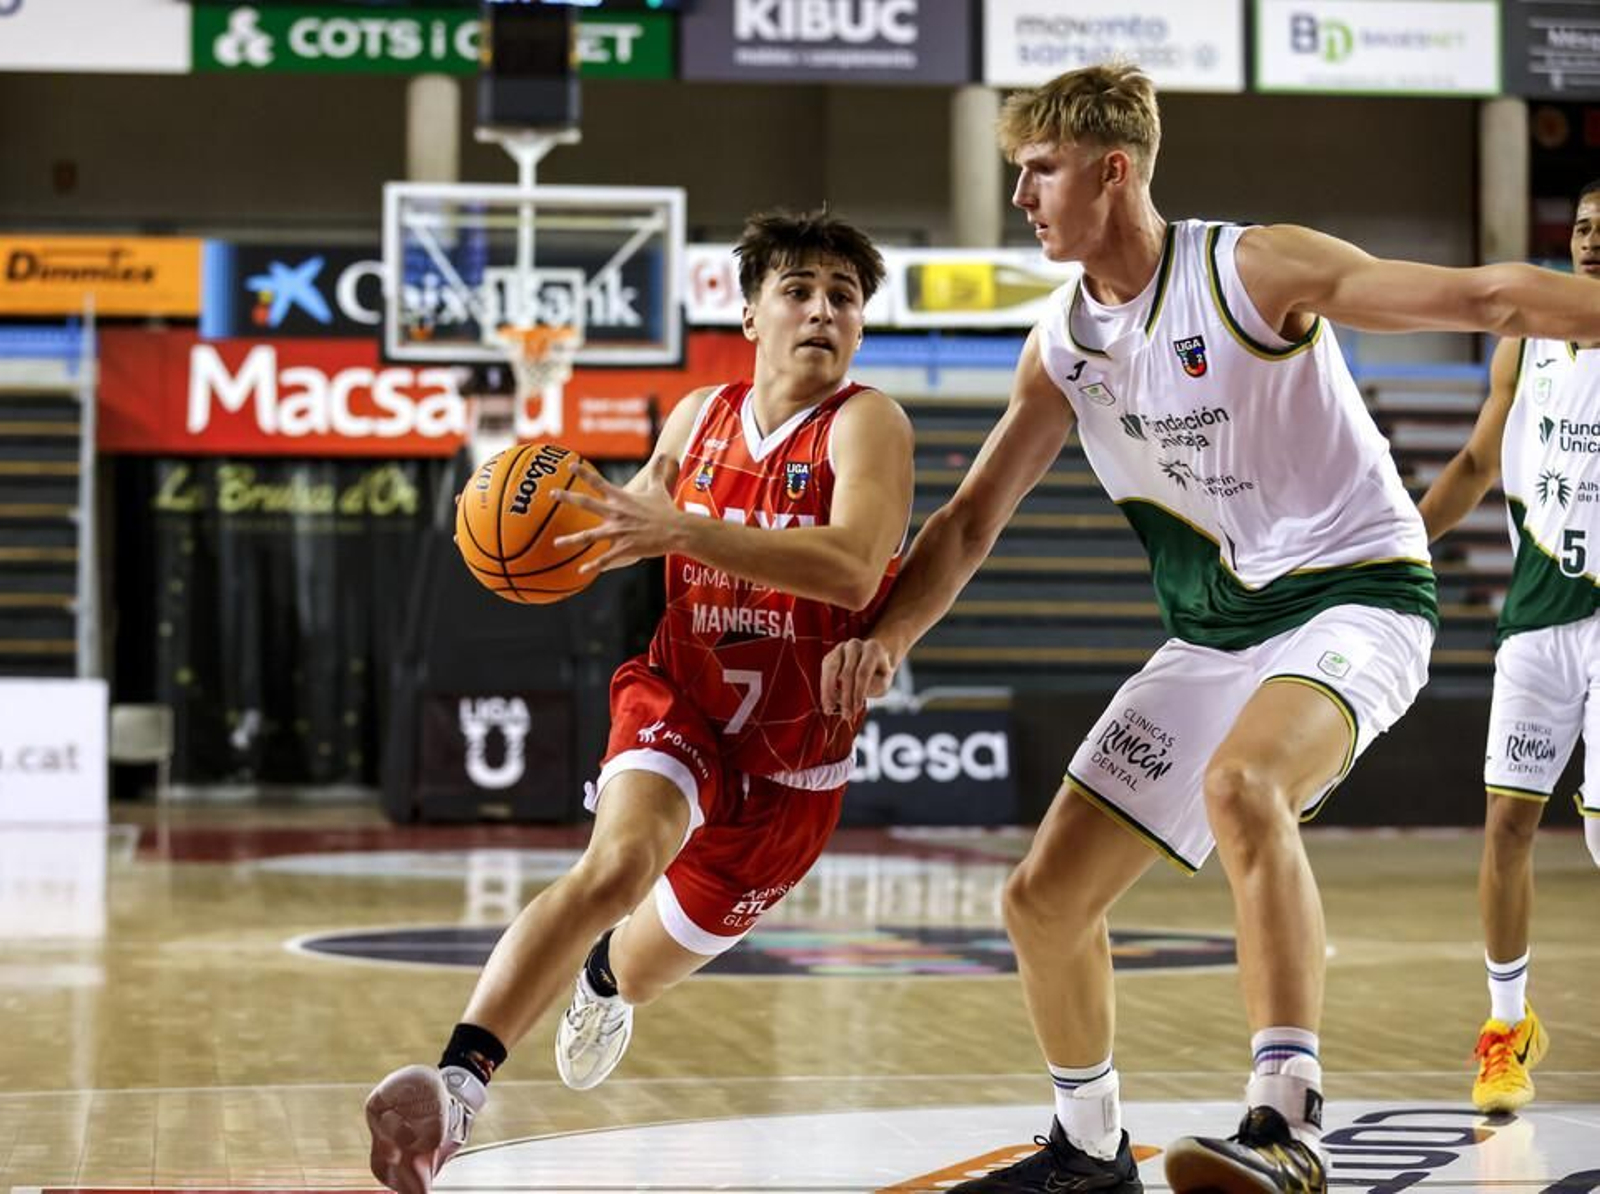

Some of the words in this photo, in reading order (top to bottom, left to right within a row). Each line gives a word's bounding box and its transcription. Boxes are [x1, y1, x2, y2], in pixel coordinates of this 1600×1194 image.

[288, 17, 423, 59] COTS
[430, 18, 445, 59] i
[454, 19, 644, 60] CET
[733, 0, 918, 44] KIBUC
[1176, 339, 1202, 351] LIGA
[186, 344, 467, 437] Macsa
[1560, 437, 1600, 453] Unic
[786, 463, 809, 474] LIGA
[1562, 530, 1587, 575] 5
[691, 602, 797, 643] MANRESA
[722, 669, 763, 735] 7
[850, 720, 1009, 782] desa
[1091, 751, 1139, 791] DENTAL
